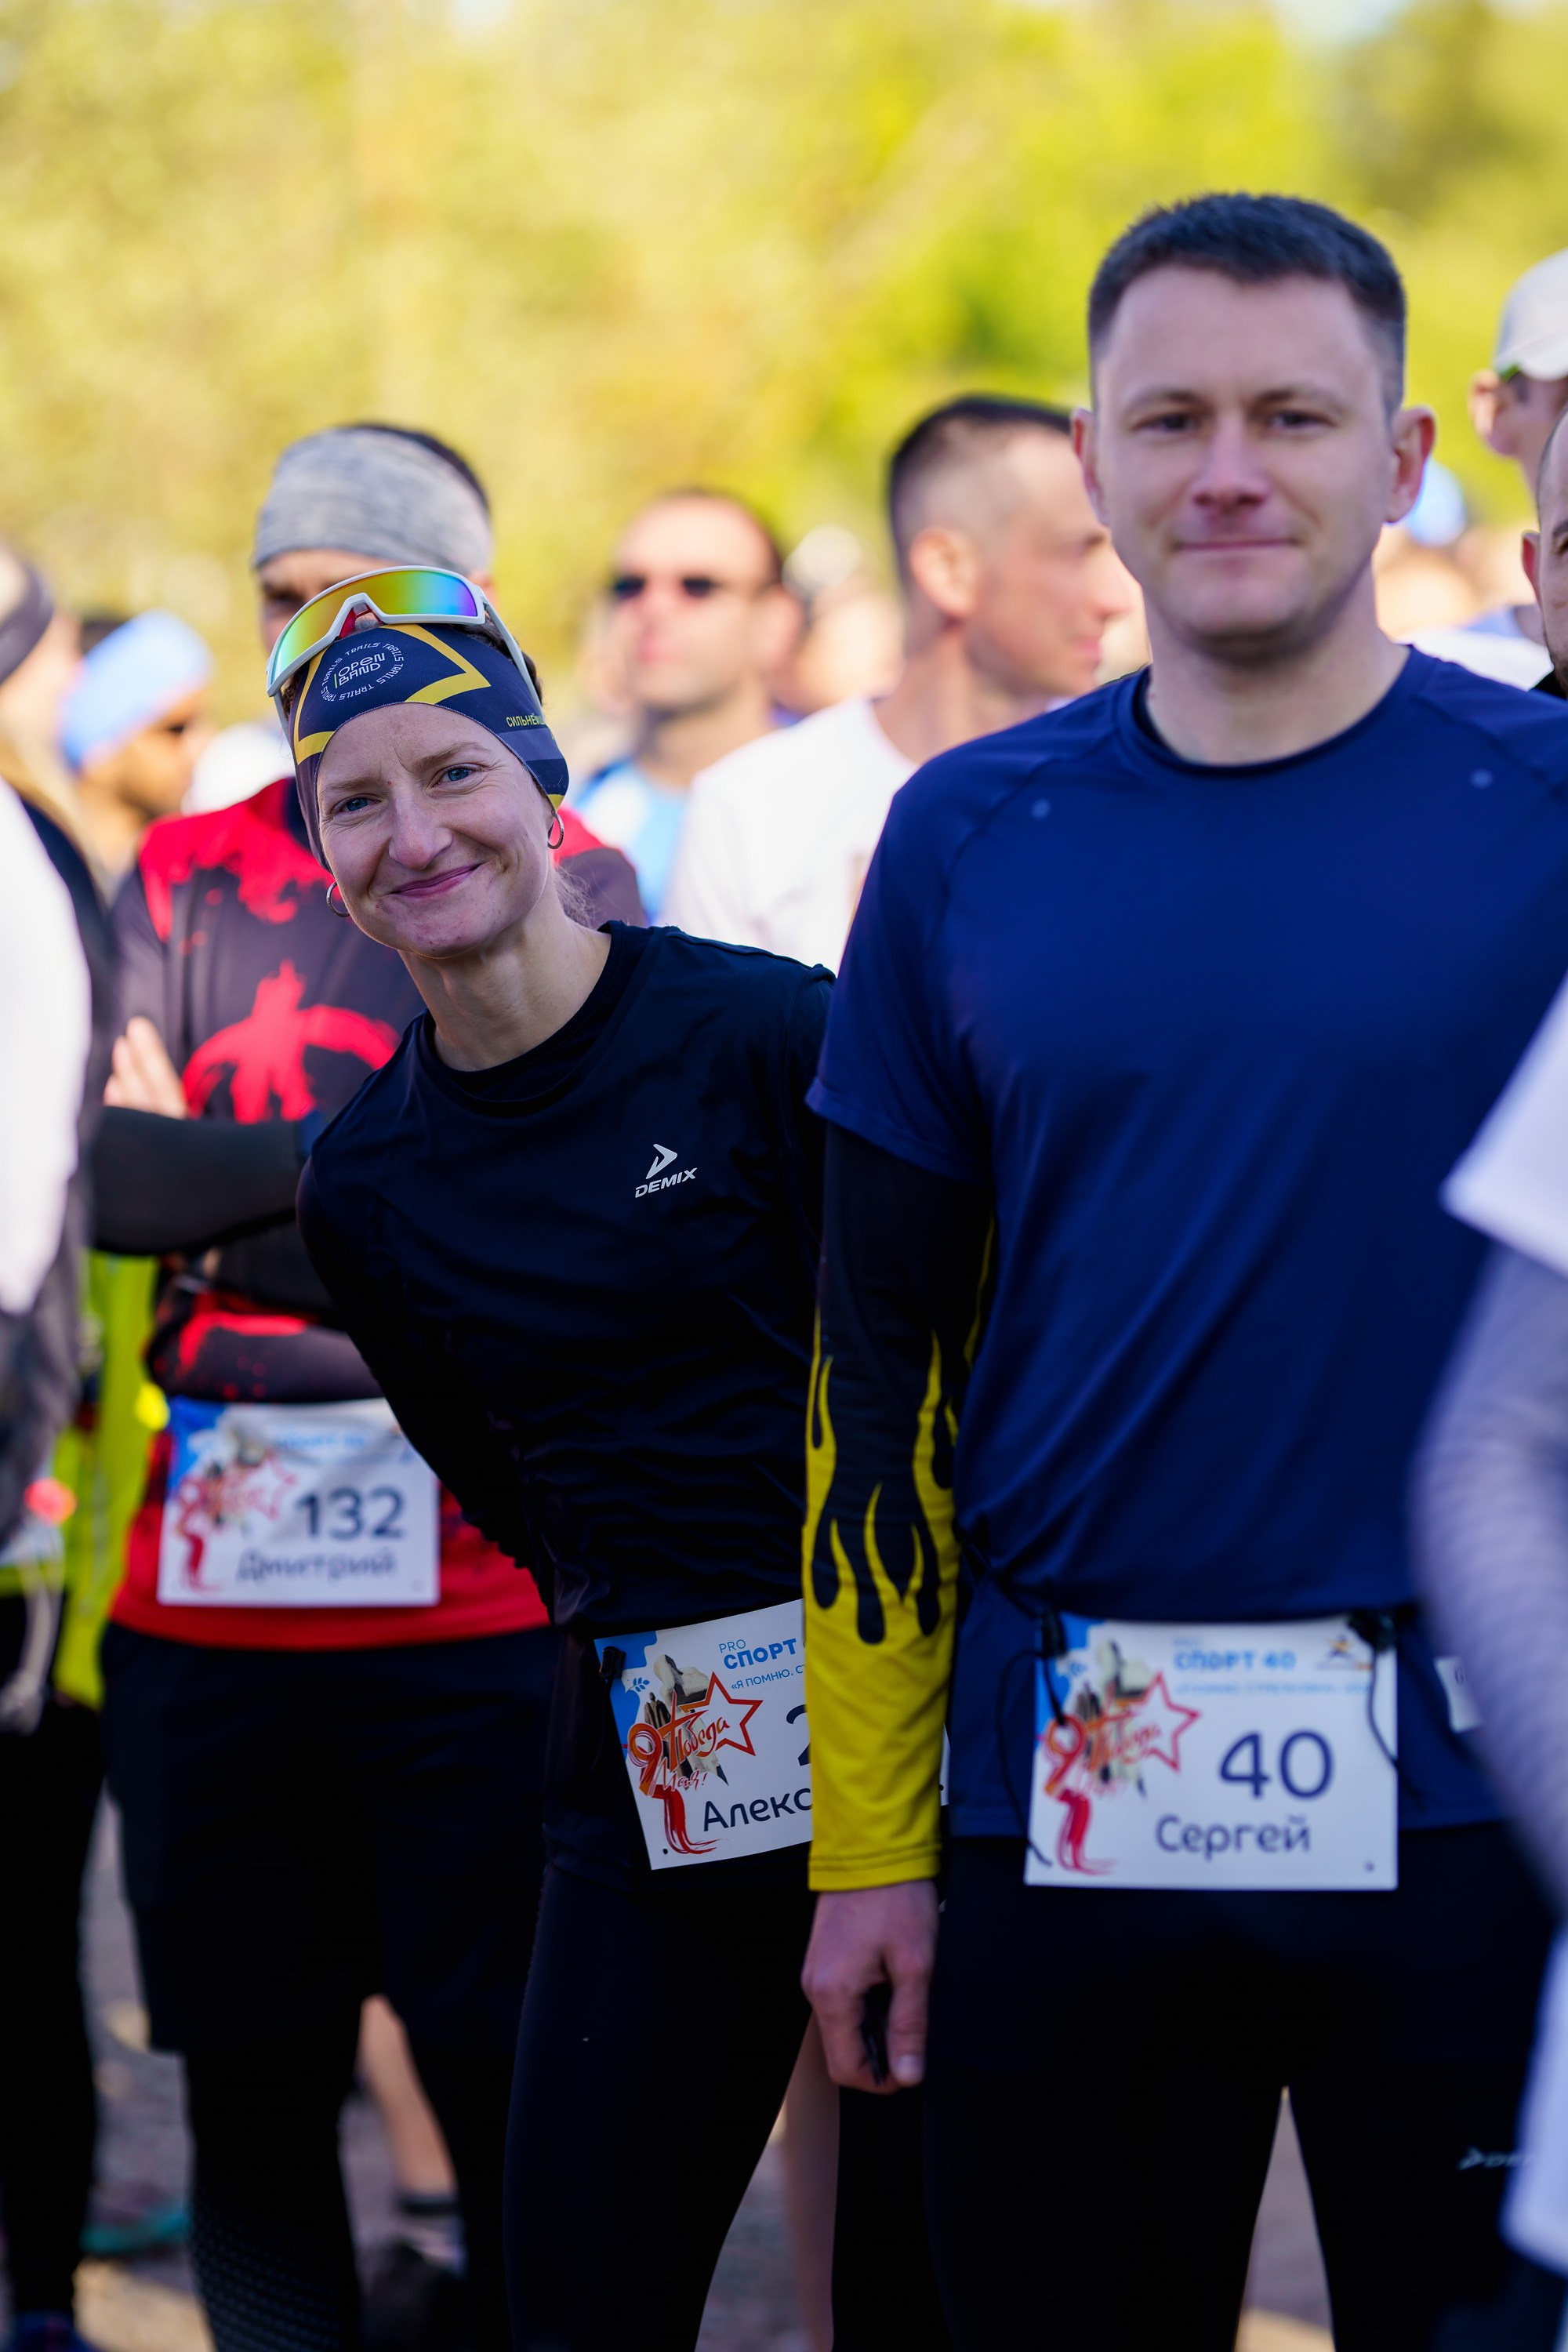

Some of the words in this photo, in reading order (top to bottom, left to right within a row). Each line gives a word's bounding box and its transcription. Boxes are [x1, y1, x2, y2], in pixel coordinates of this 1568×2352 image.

[345, 642, 381, 655] TRAILS
[383, 643, 405, 662] TRAILS
[321, 657, 343, 687] TRAILS
[339, 662, 381, 686] BAND
[376, 663, 404, 684] TRAILS
[339, 684, 375, 701] TRAILS
[634, 1167, 698, 1198] DEMIX
[296, 1486, 405, 1541] 132
[718, 1639, 746, 1653] PRO
[724, 1638, 797, 1670] СПОРТ
[1174, 1650, 1255, 1670] СПОРТ
[1263, 1650, 1298, 1670] 40
[746, 1668, 793, 1686] ПОМНЮ.
[657, 1689, 731, 1773] Победа
[1219, 1730, 1333, 1800] 40
[704, 1788, 812, 1832] Алекс
[1156, 1814, 1311, 1863] Сергей
